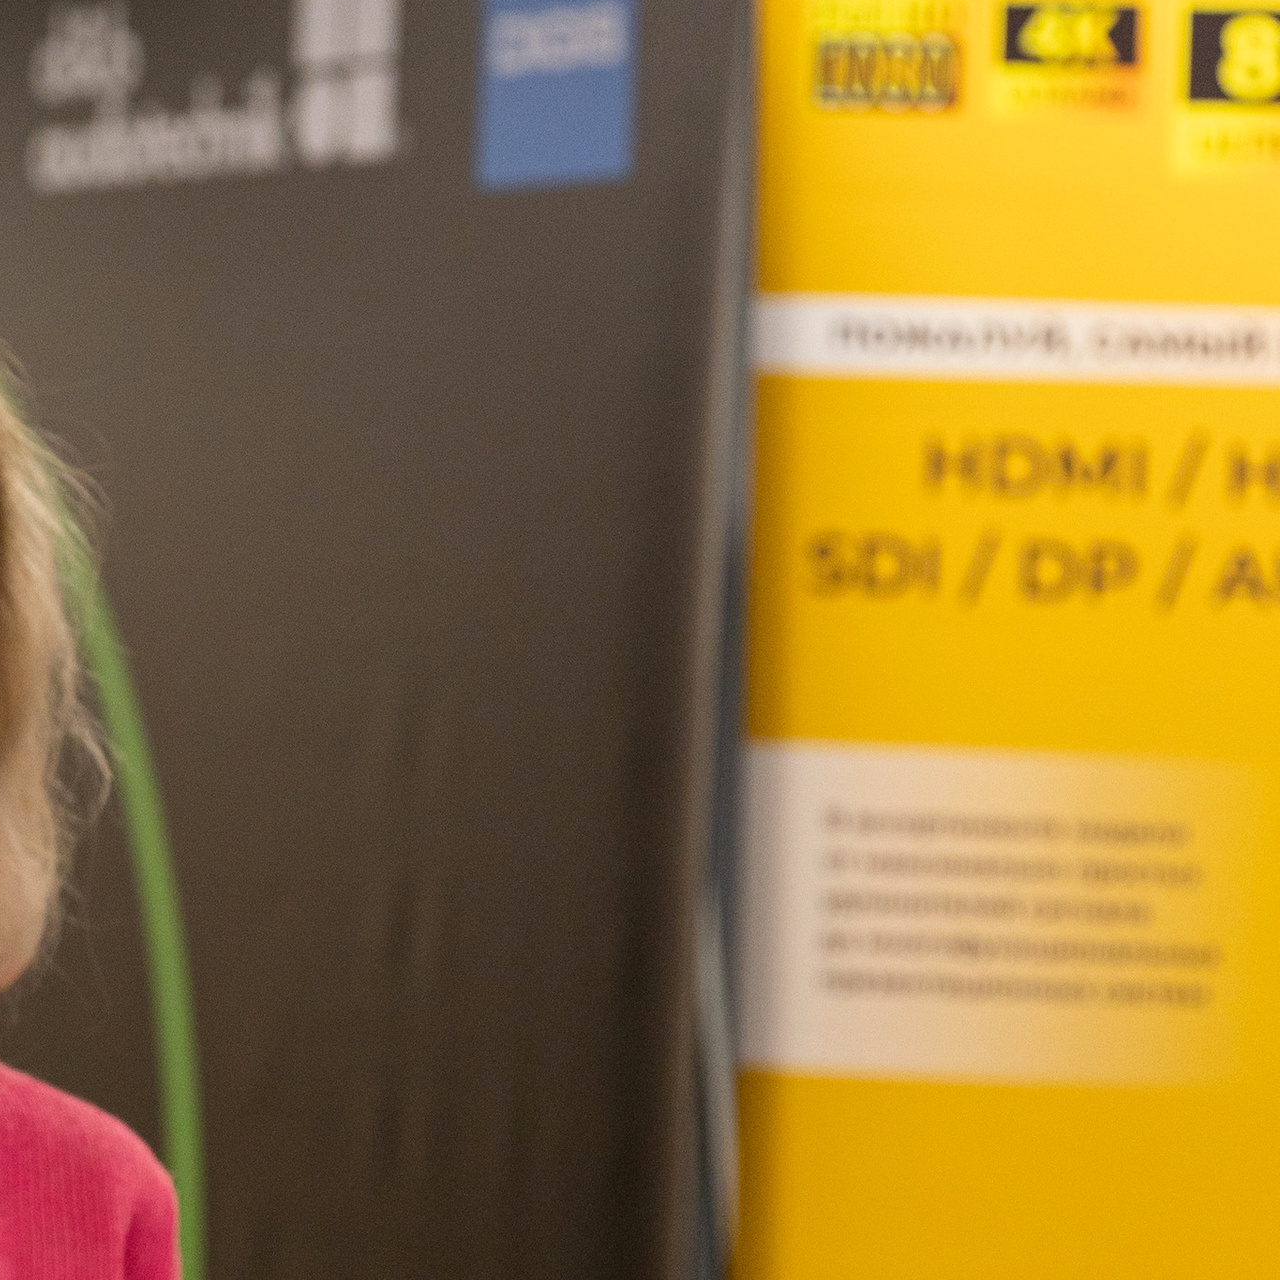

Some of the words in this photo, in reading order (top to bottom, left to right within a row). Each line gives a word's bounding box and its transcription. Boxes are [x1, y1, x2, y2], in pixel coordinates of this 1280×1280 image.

[924, 435, 1148, 500] HDMI
[811, 530, 940, 597] SDI
[1022, 538, 1139, 605] DP
